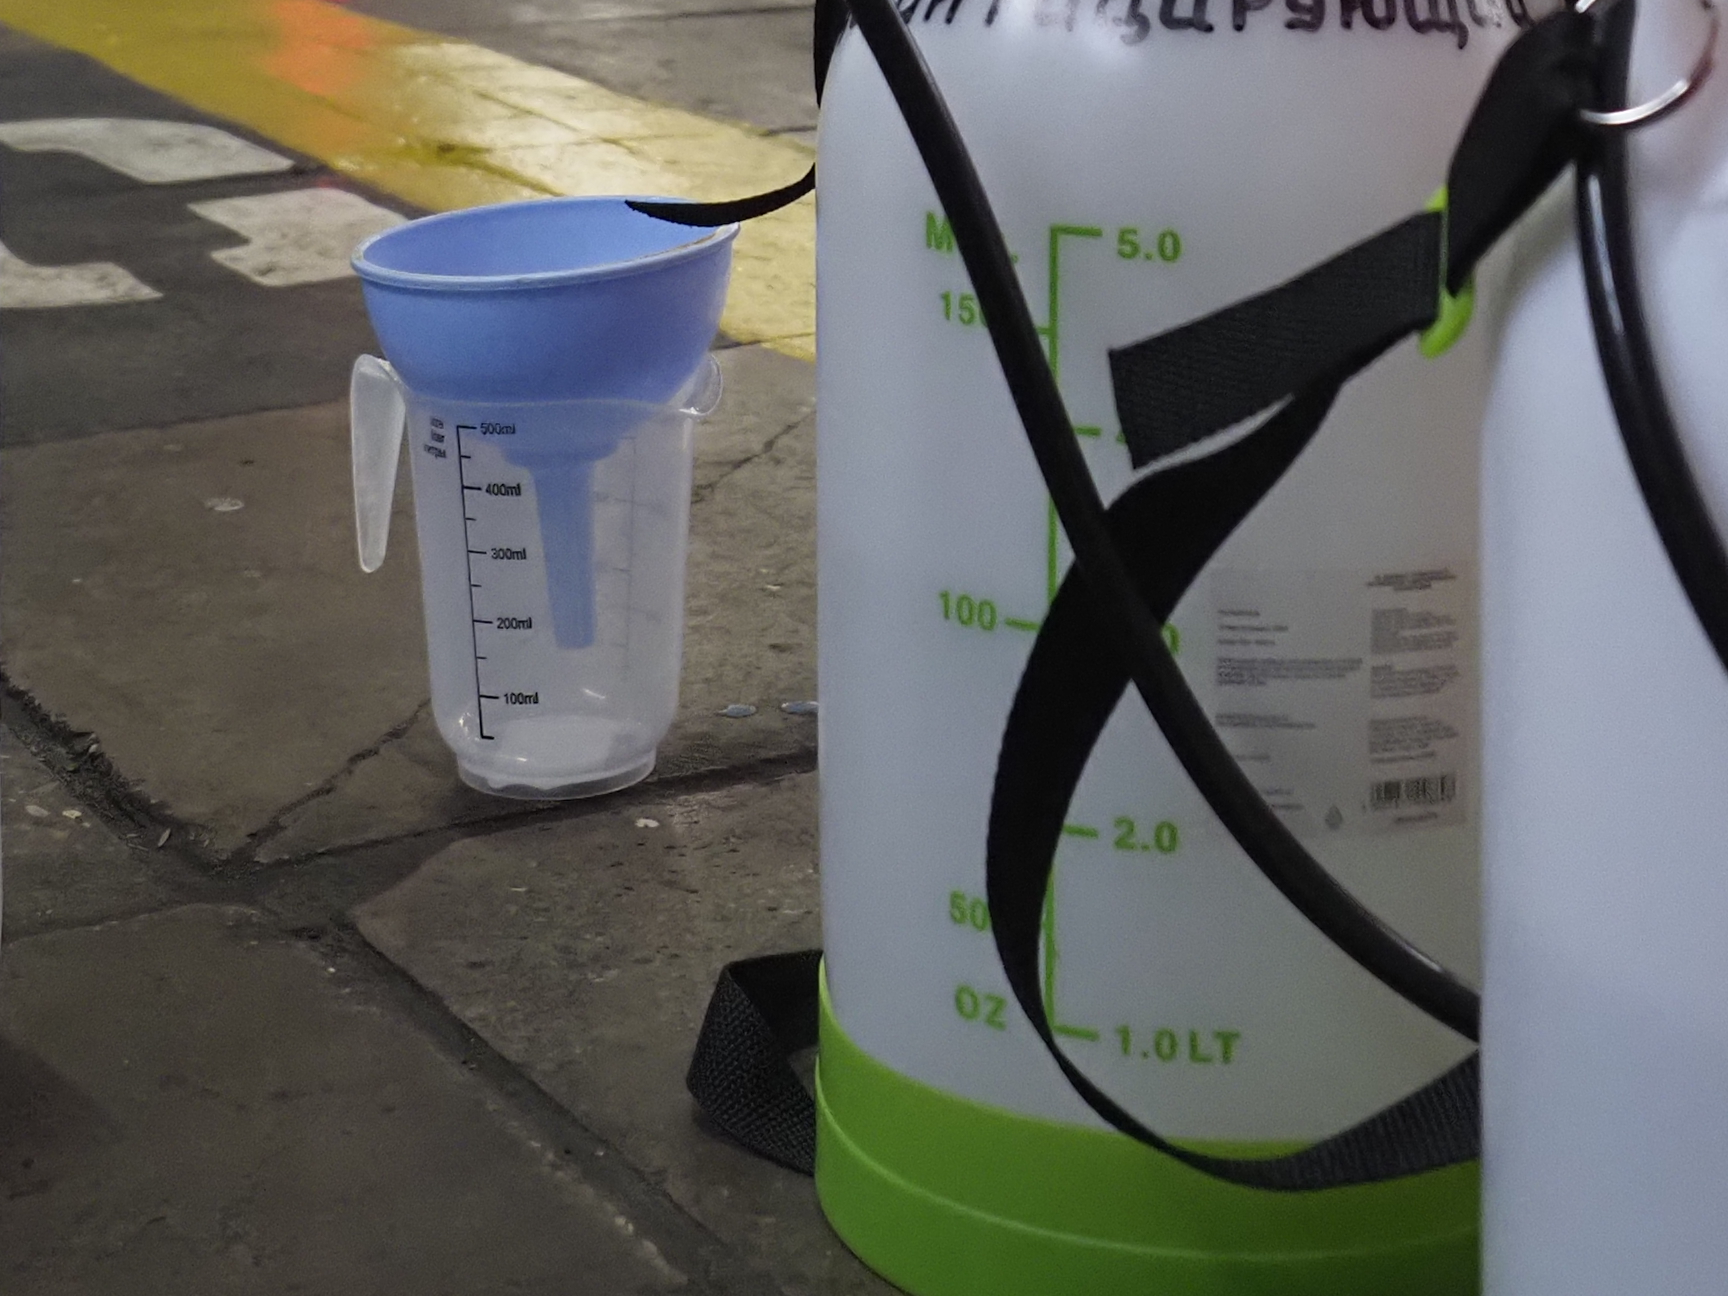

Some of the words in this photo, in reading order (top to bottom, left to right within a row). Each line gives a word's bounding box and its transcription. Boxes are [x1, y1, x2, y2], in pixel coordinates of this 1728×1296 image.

[1117, 227, 1182, 264] 5.0
[480, 421, 517, 436] 500ml
[485, 482, 522, 497] 400ml
[491, 547, 528, 562] 300ml
[939, 590, 998, 632] 100
[497, 616, 534, 631] 200ml
[503, 691, 540, 706] 100ml
[1113, 816, 1179, 854] 2.0
[949, 888, 991, 934] 50
